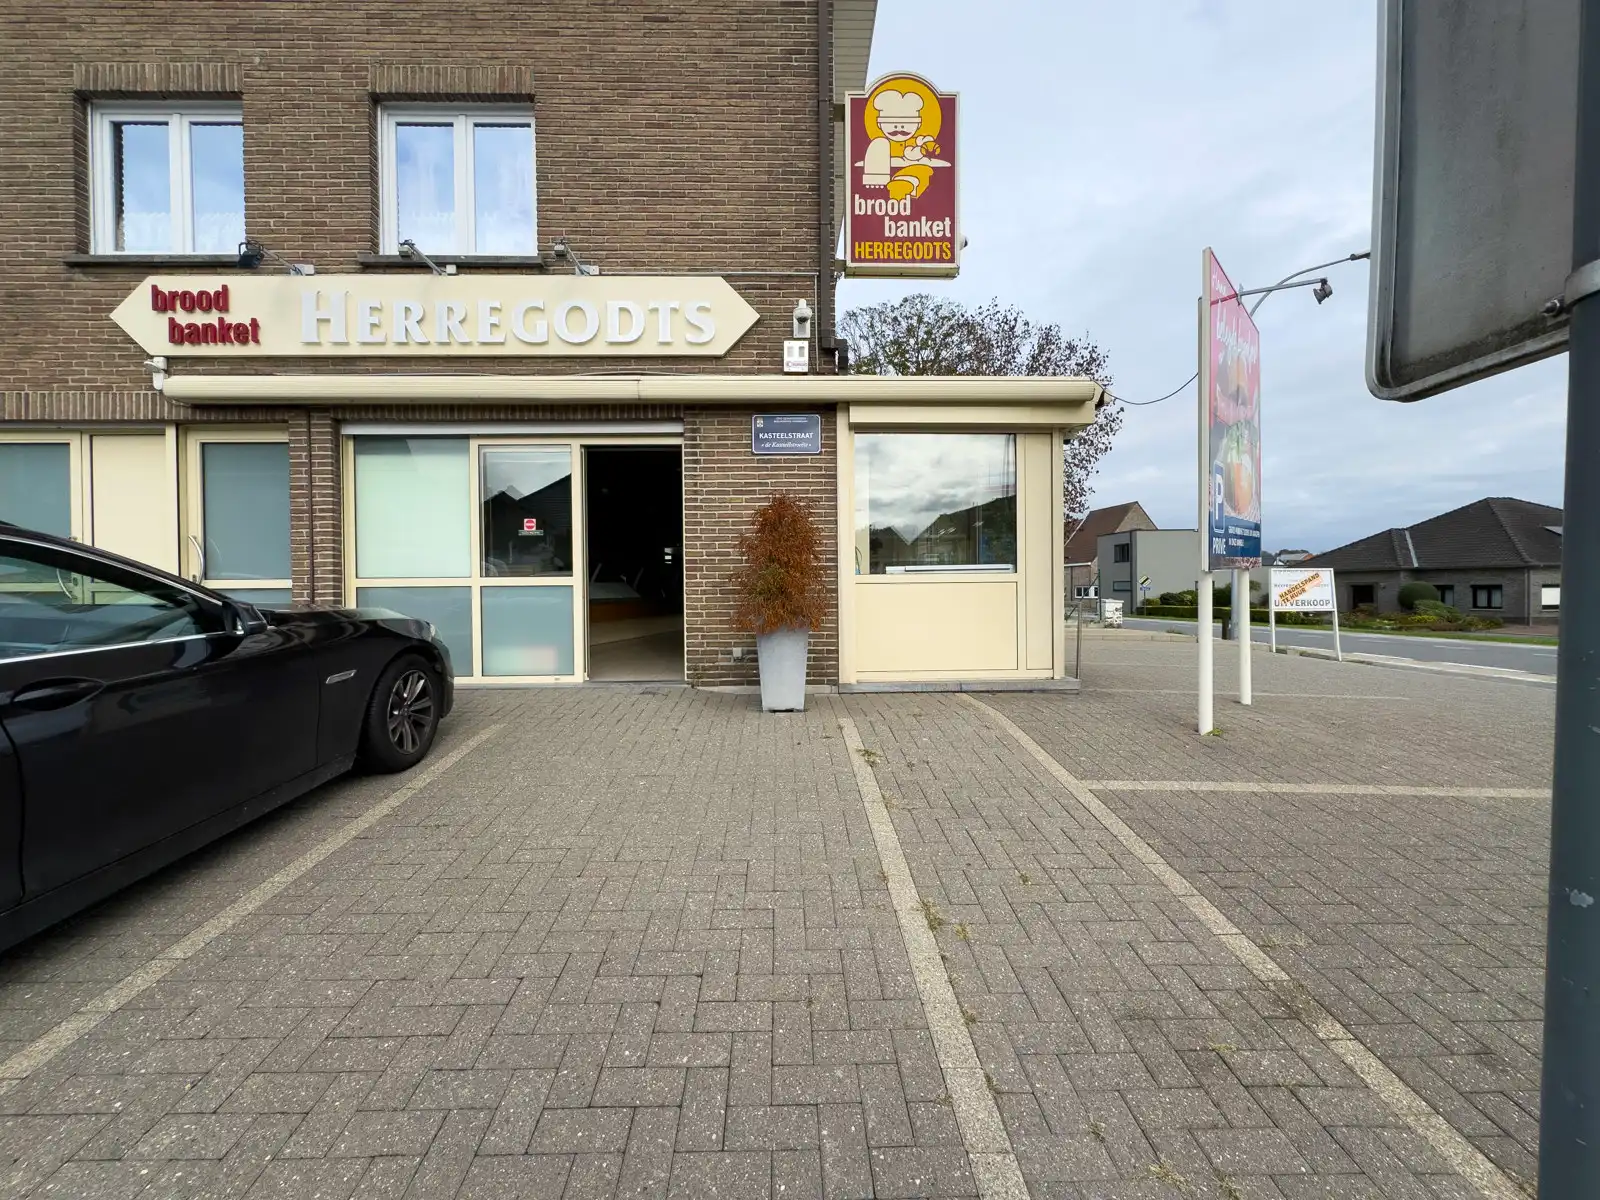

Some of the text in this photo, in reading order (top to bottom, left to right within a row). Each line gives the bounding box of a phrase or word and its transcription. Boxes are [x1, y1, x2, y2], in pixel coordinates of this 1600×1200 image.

[855, 194, 911, 216] brood
[884, 216, 951, 238] banket
[855, 241, 952, 260] HERREGODTS
[151, 284, 230, 313] brood
[300, 290, 717, 345] HERREGODTS
[168, 316, 261, 345] banket
